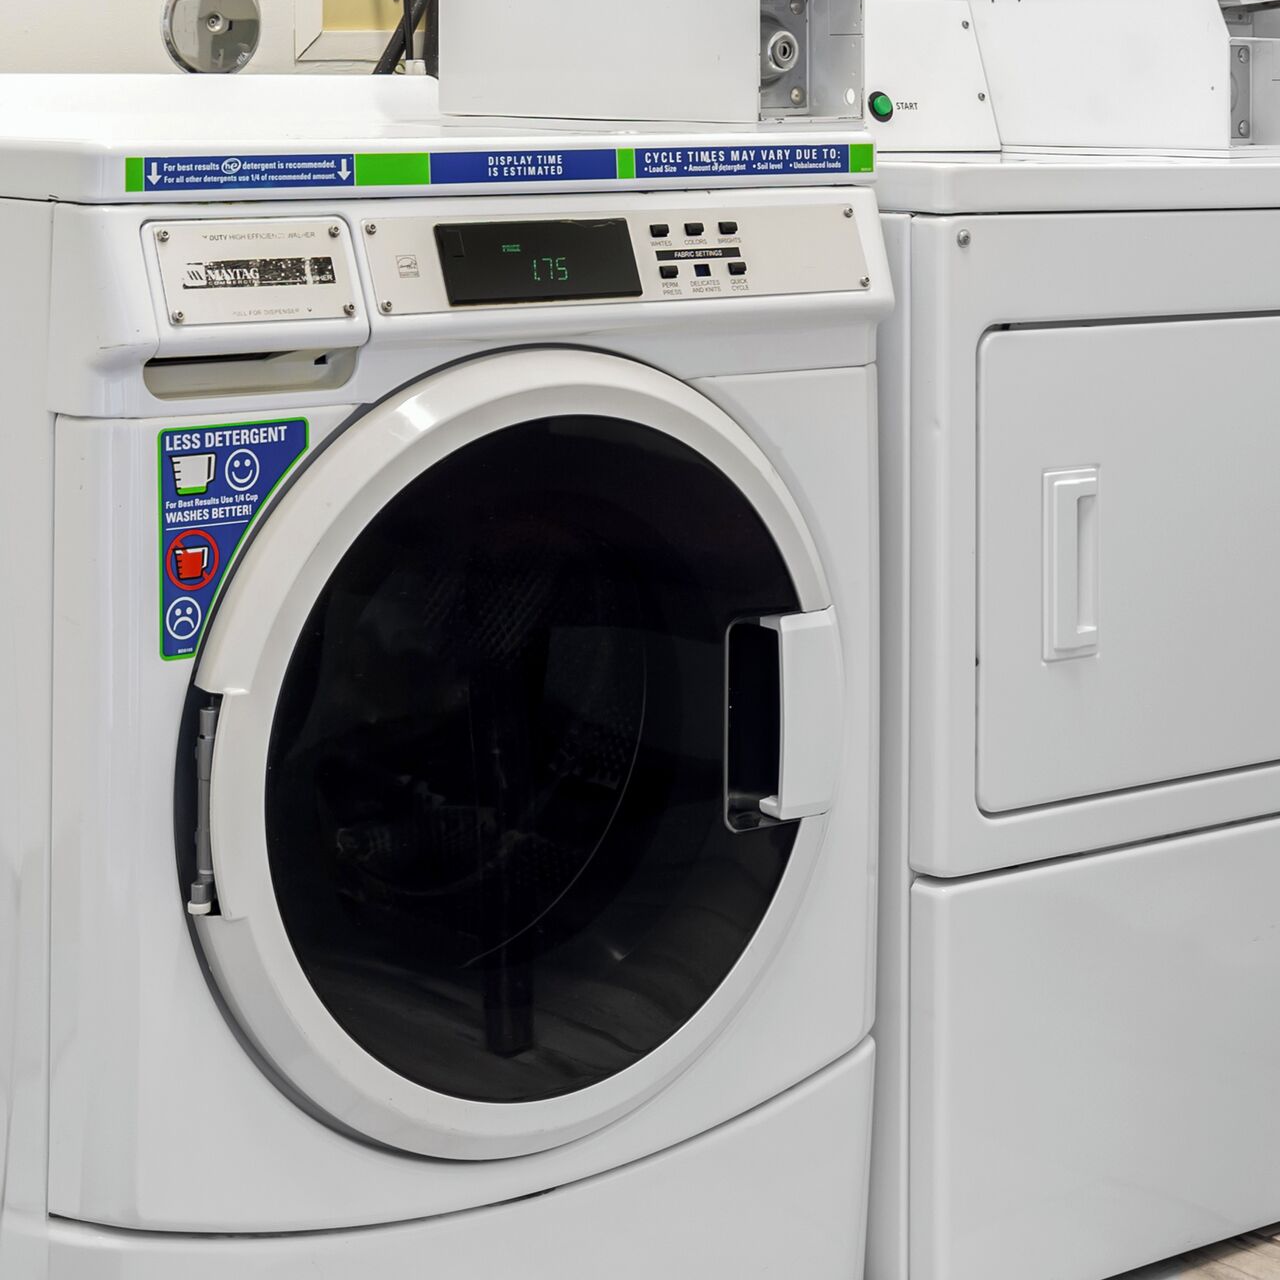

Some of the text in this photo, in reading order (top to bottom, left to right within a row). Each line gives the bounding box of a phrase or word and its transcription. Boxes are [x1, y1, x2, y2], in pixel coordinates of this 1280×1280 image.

[896, 102, 918, 110] START
[488, 154, 563, 166] DISPLAY TIME
[644, 147, 841, 164] CYCLE TIMES MAY VARY DUE TO:
[164, 163, 175, 171] For
[176, 162, 193, 171] best
[194, 161, 219, 171] results
[242, 161, 276, 172] detergent
[278, 161, 284, 169] is
[285, 160, 336, 169] recommended.
[488, 165, 563, 177] IS ESTIMATED
[649, 165, 663, 173] Load
[664, 164, 678, 173] Size
[688, 163, 711, 172] Amount
[757, 162, 768, 170] Soil
[769, 161, 783, 170] level
[793, 161, 826, 170] Unbalanced
[827, 160, 841, 169] loads
[176, 175, 184, 183] all
[185, 175, 202, 183] other
[204, 174, 237, 184] detergents
[251, 173, 260, 182] 1/4
[261, 173, 268, 181] of
[268, 172, 310, 181] recommended
[312, 172, 336, 180] amount.
[209, 233, 228, 241] DUTY
[674, 250, 695, 258] FABRIC
[207, 268, 260, 281] MAYTAG
[705, 285, 722, 293] KNITS
[165, 426, 287, 451] LESS DETERGENT
[166, 493, 258, 509] For Best Results Use 1/4 Cup
[166, 505, 252, 524] WASHES BETTER!
